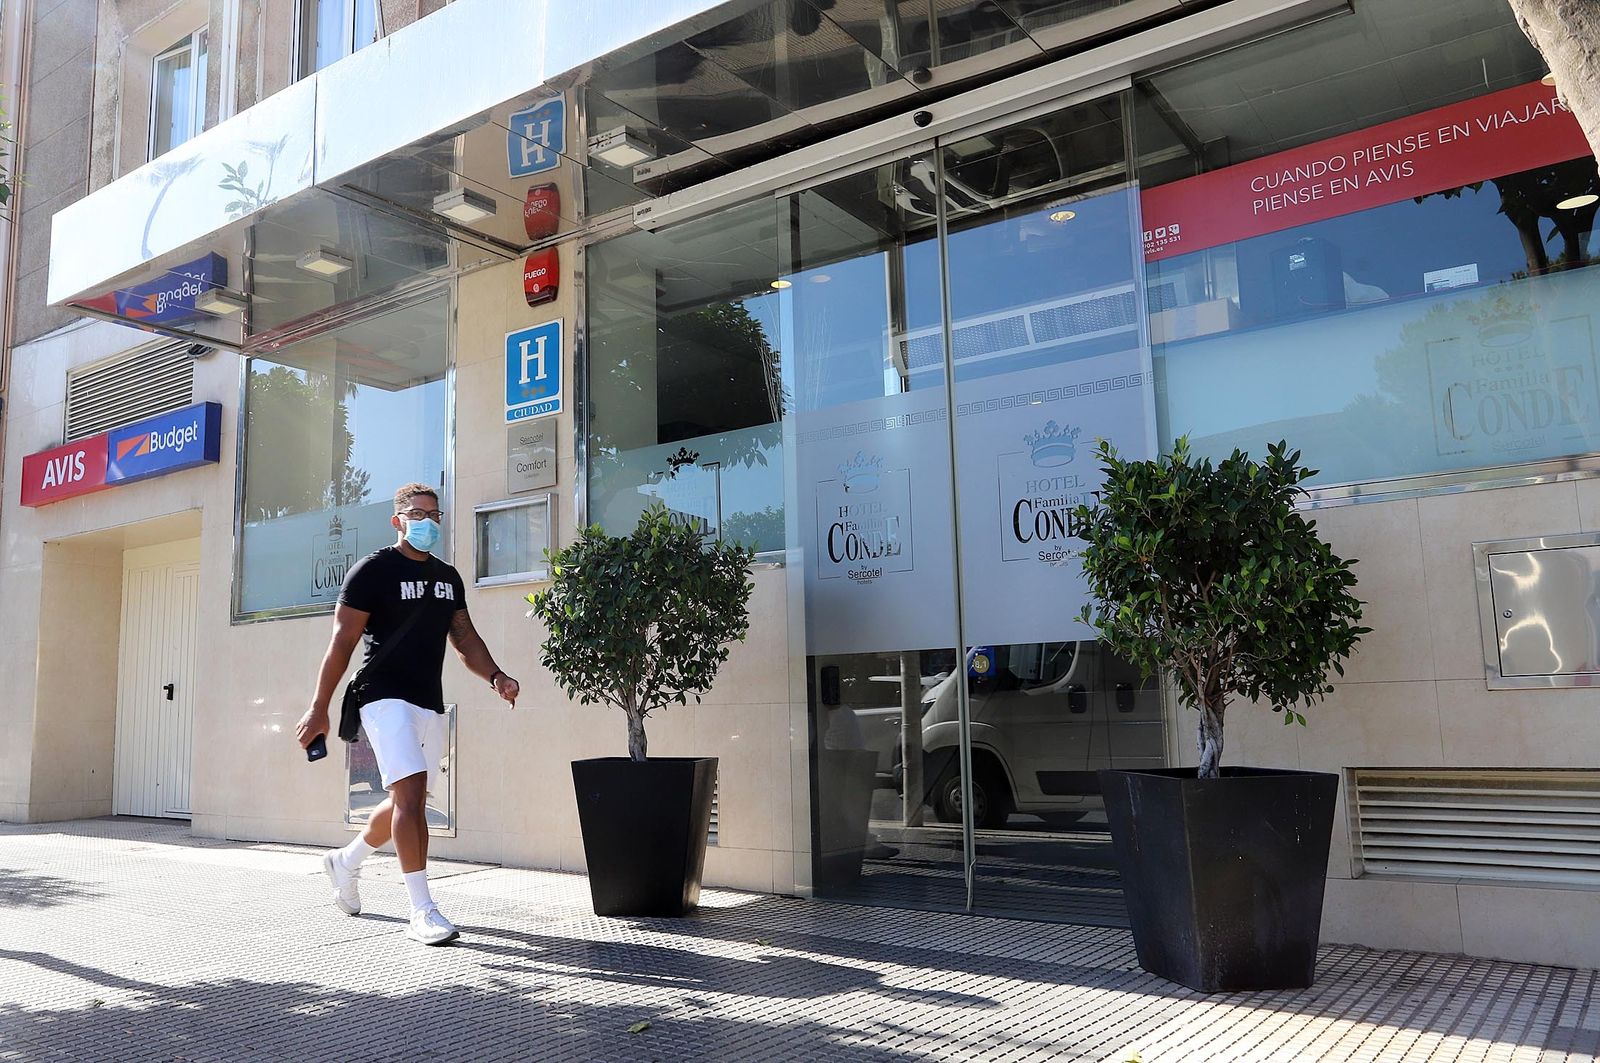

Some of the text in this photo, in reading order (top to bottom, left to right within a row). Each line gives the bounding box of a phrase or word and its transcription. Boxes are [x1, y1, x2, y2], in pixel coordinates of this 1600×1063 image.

[1250, 155, 1346, 193] CUANDO
[1352, 131, 1432, 167] PIENSE
[1437, 121, 1471, 144] EN
[1252, 160, 1415, 215] PIENSE EN AVIS
[524, 267, 547, 281] FUEGO
[518, 335, 548, 385] H
[513, 402, 553, 419] CIUDAD
[41, 420, 198, 490] AVIS Budget
[516, 460, 547, 474] Comfort
[1026, 474, 1087, 494] HOTEL
[1034, 493, 1080, 509] Familia
[827, 515, 902, 564] CONDE
[847, 568, 883, 580] Sercotel
